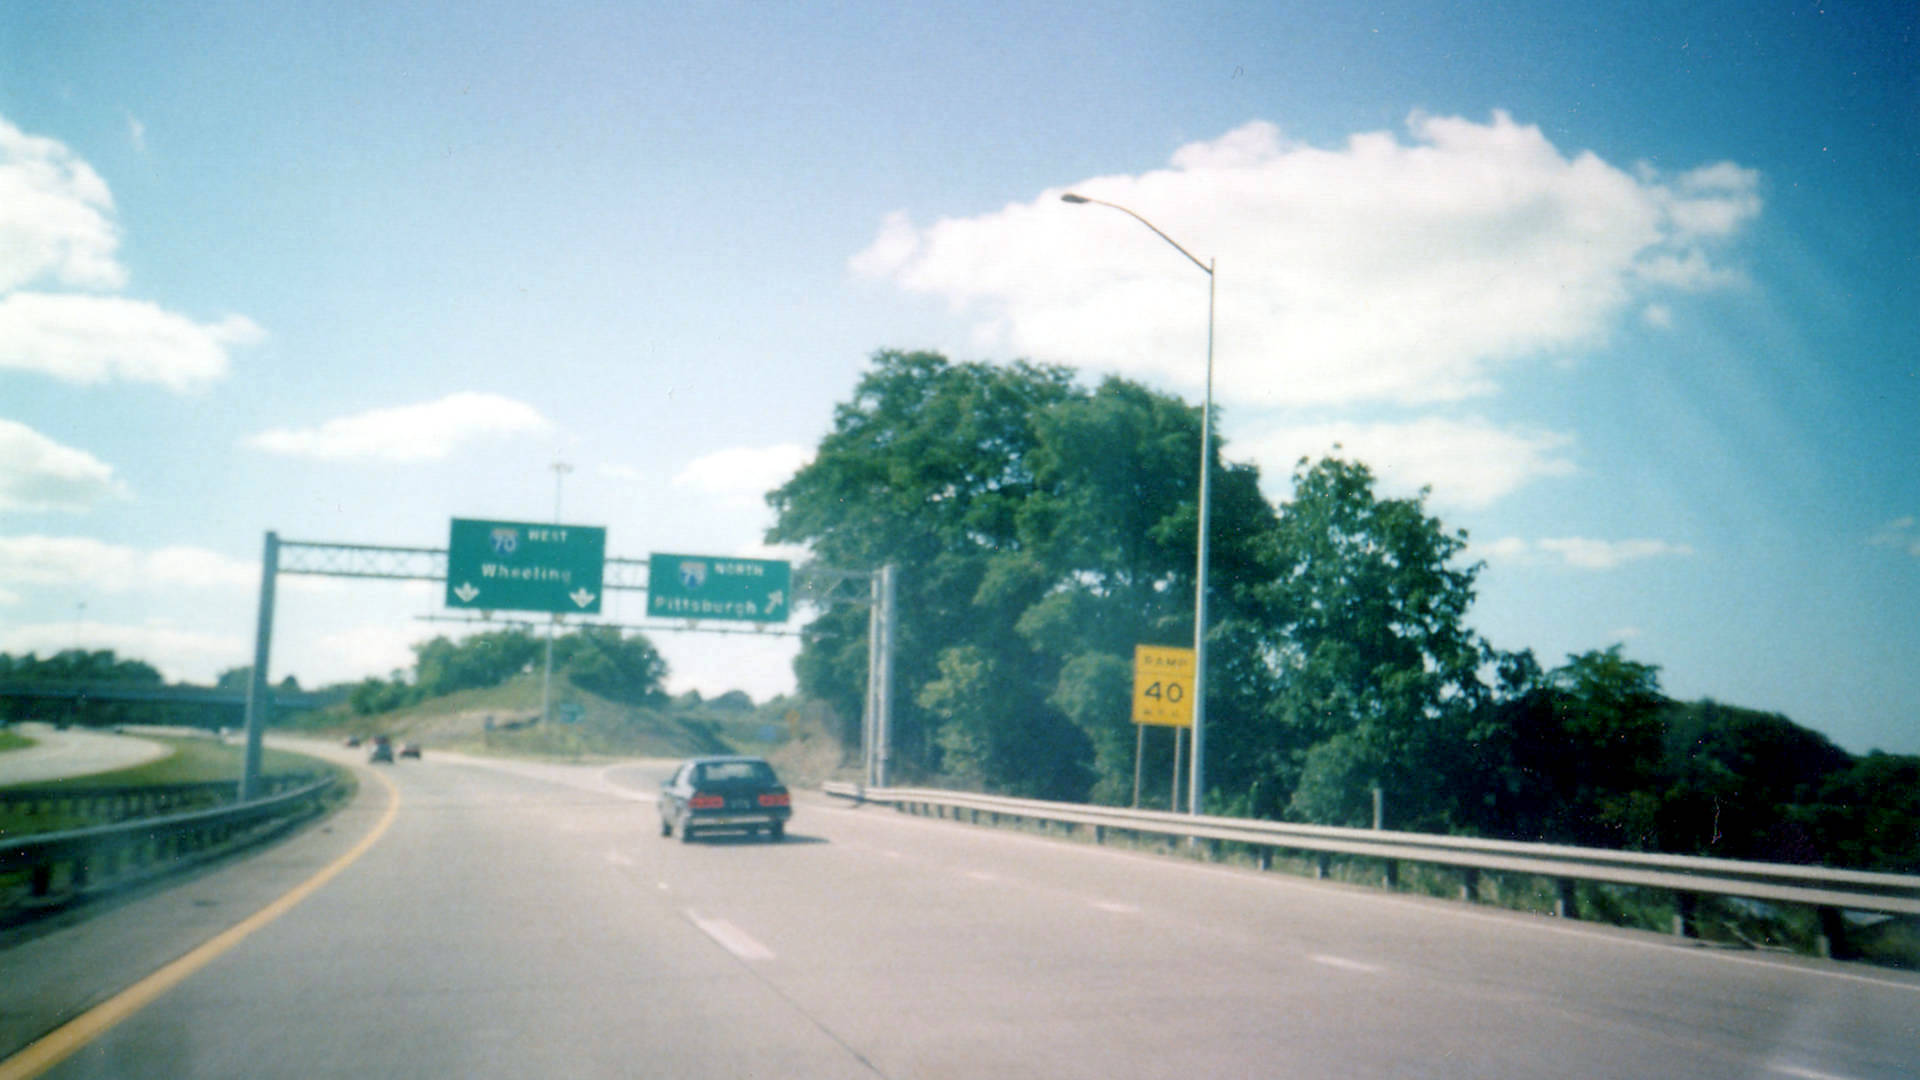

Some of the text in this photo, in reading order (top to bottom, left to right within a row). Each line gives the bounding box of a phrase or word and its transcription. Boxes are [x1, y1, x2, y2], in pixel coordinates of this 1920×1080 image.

[493, 530, 568, 553] 70 WEST
[481, 563, 571, 584] Wheeling
[715, 562, 764, 576] NORTH
[655, 596, 757, 617] Pittsburgh
[1144, 681, 1184, 703] 40
